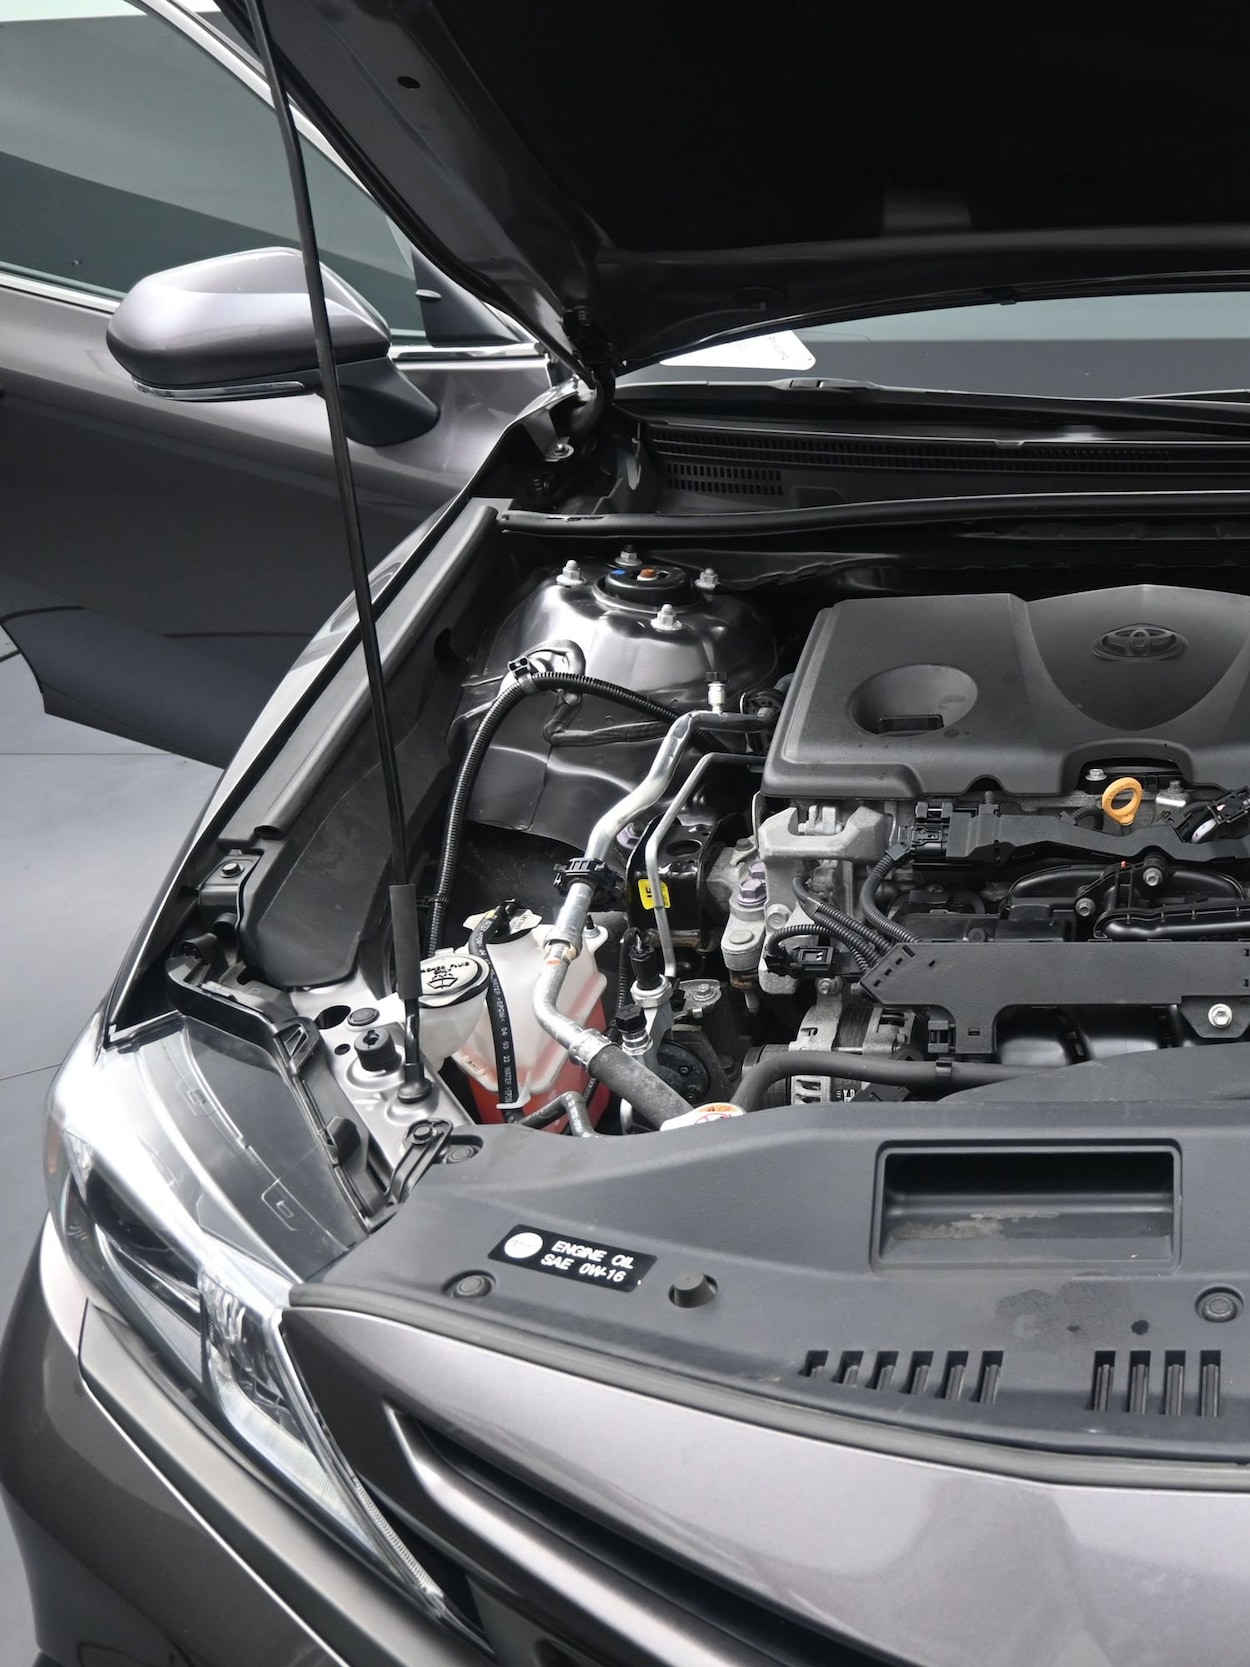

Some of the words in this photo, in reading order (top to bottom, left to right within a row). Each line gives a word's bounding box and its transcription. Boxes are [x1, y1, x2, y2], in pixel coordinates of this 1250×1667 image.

[540, 1253, 575, 1270] SAE
[578, 1262, 627, 1282] 0W-16
[551, 1240, 608, 1262] ENGINE
[611, 1254, 634, 1270] OIL
